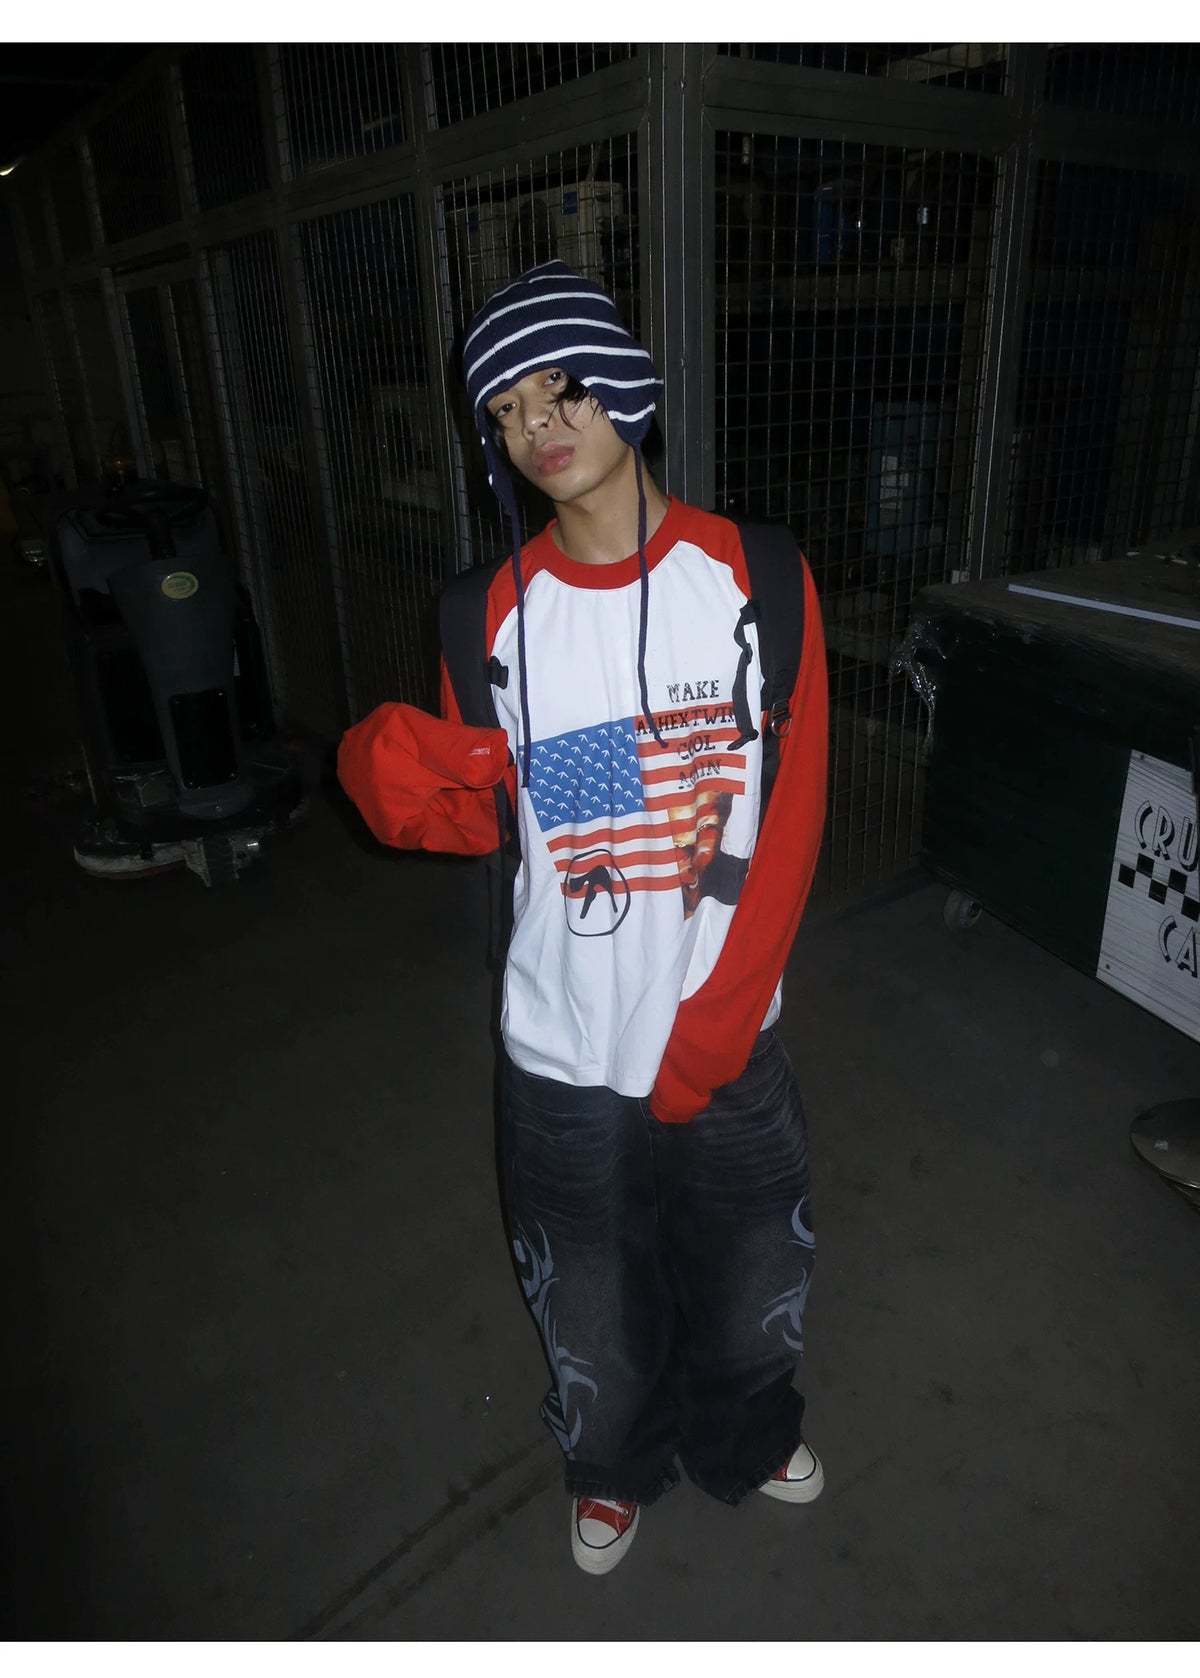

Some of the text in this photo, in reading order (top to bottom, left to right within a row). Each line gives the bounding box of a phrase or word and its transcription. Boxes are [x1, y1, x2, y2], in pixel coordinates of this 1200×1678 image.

[666, 679, 720, 703] MAKE
[636, 710, 690, 736] AHEX
[1134, 800, 1199, 872] CRU
